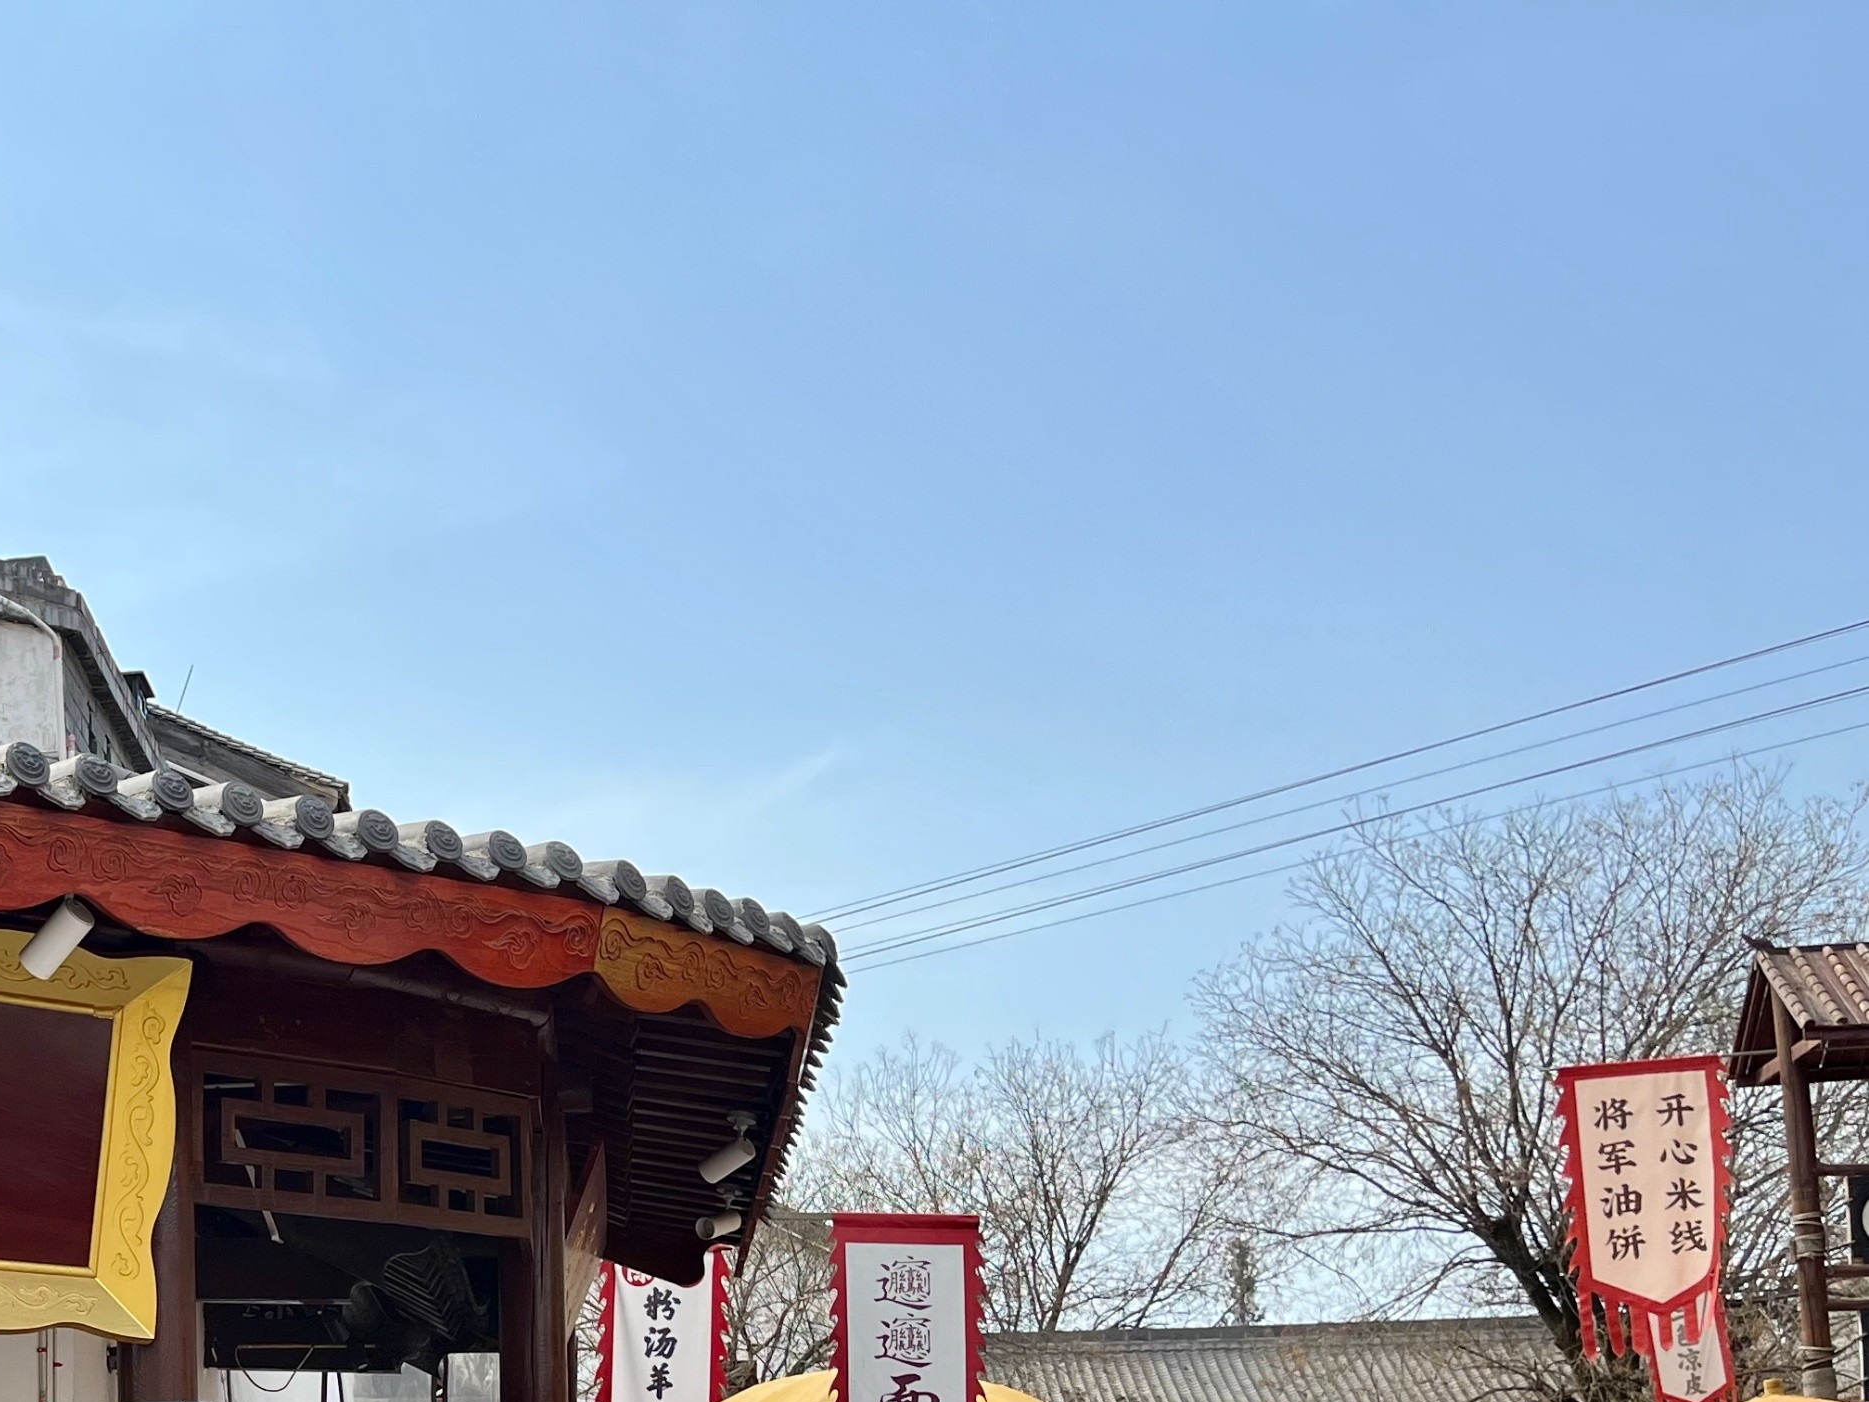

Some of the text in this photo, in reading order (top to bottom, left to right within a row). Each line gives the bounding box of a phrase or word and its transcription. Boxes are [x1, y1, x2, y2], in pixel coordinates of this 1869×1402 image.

[1593, 1096, 1646, 1261] 将军油饼
[1656, 1094, 1708, 1256] 开心米线
